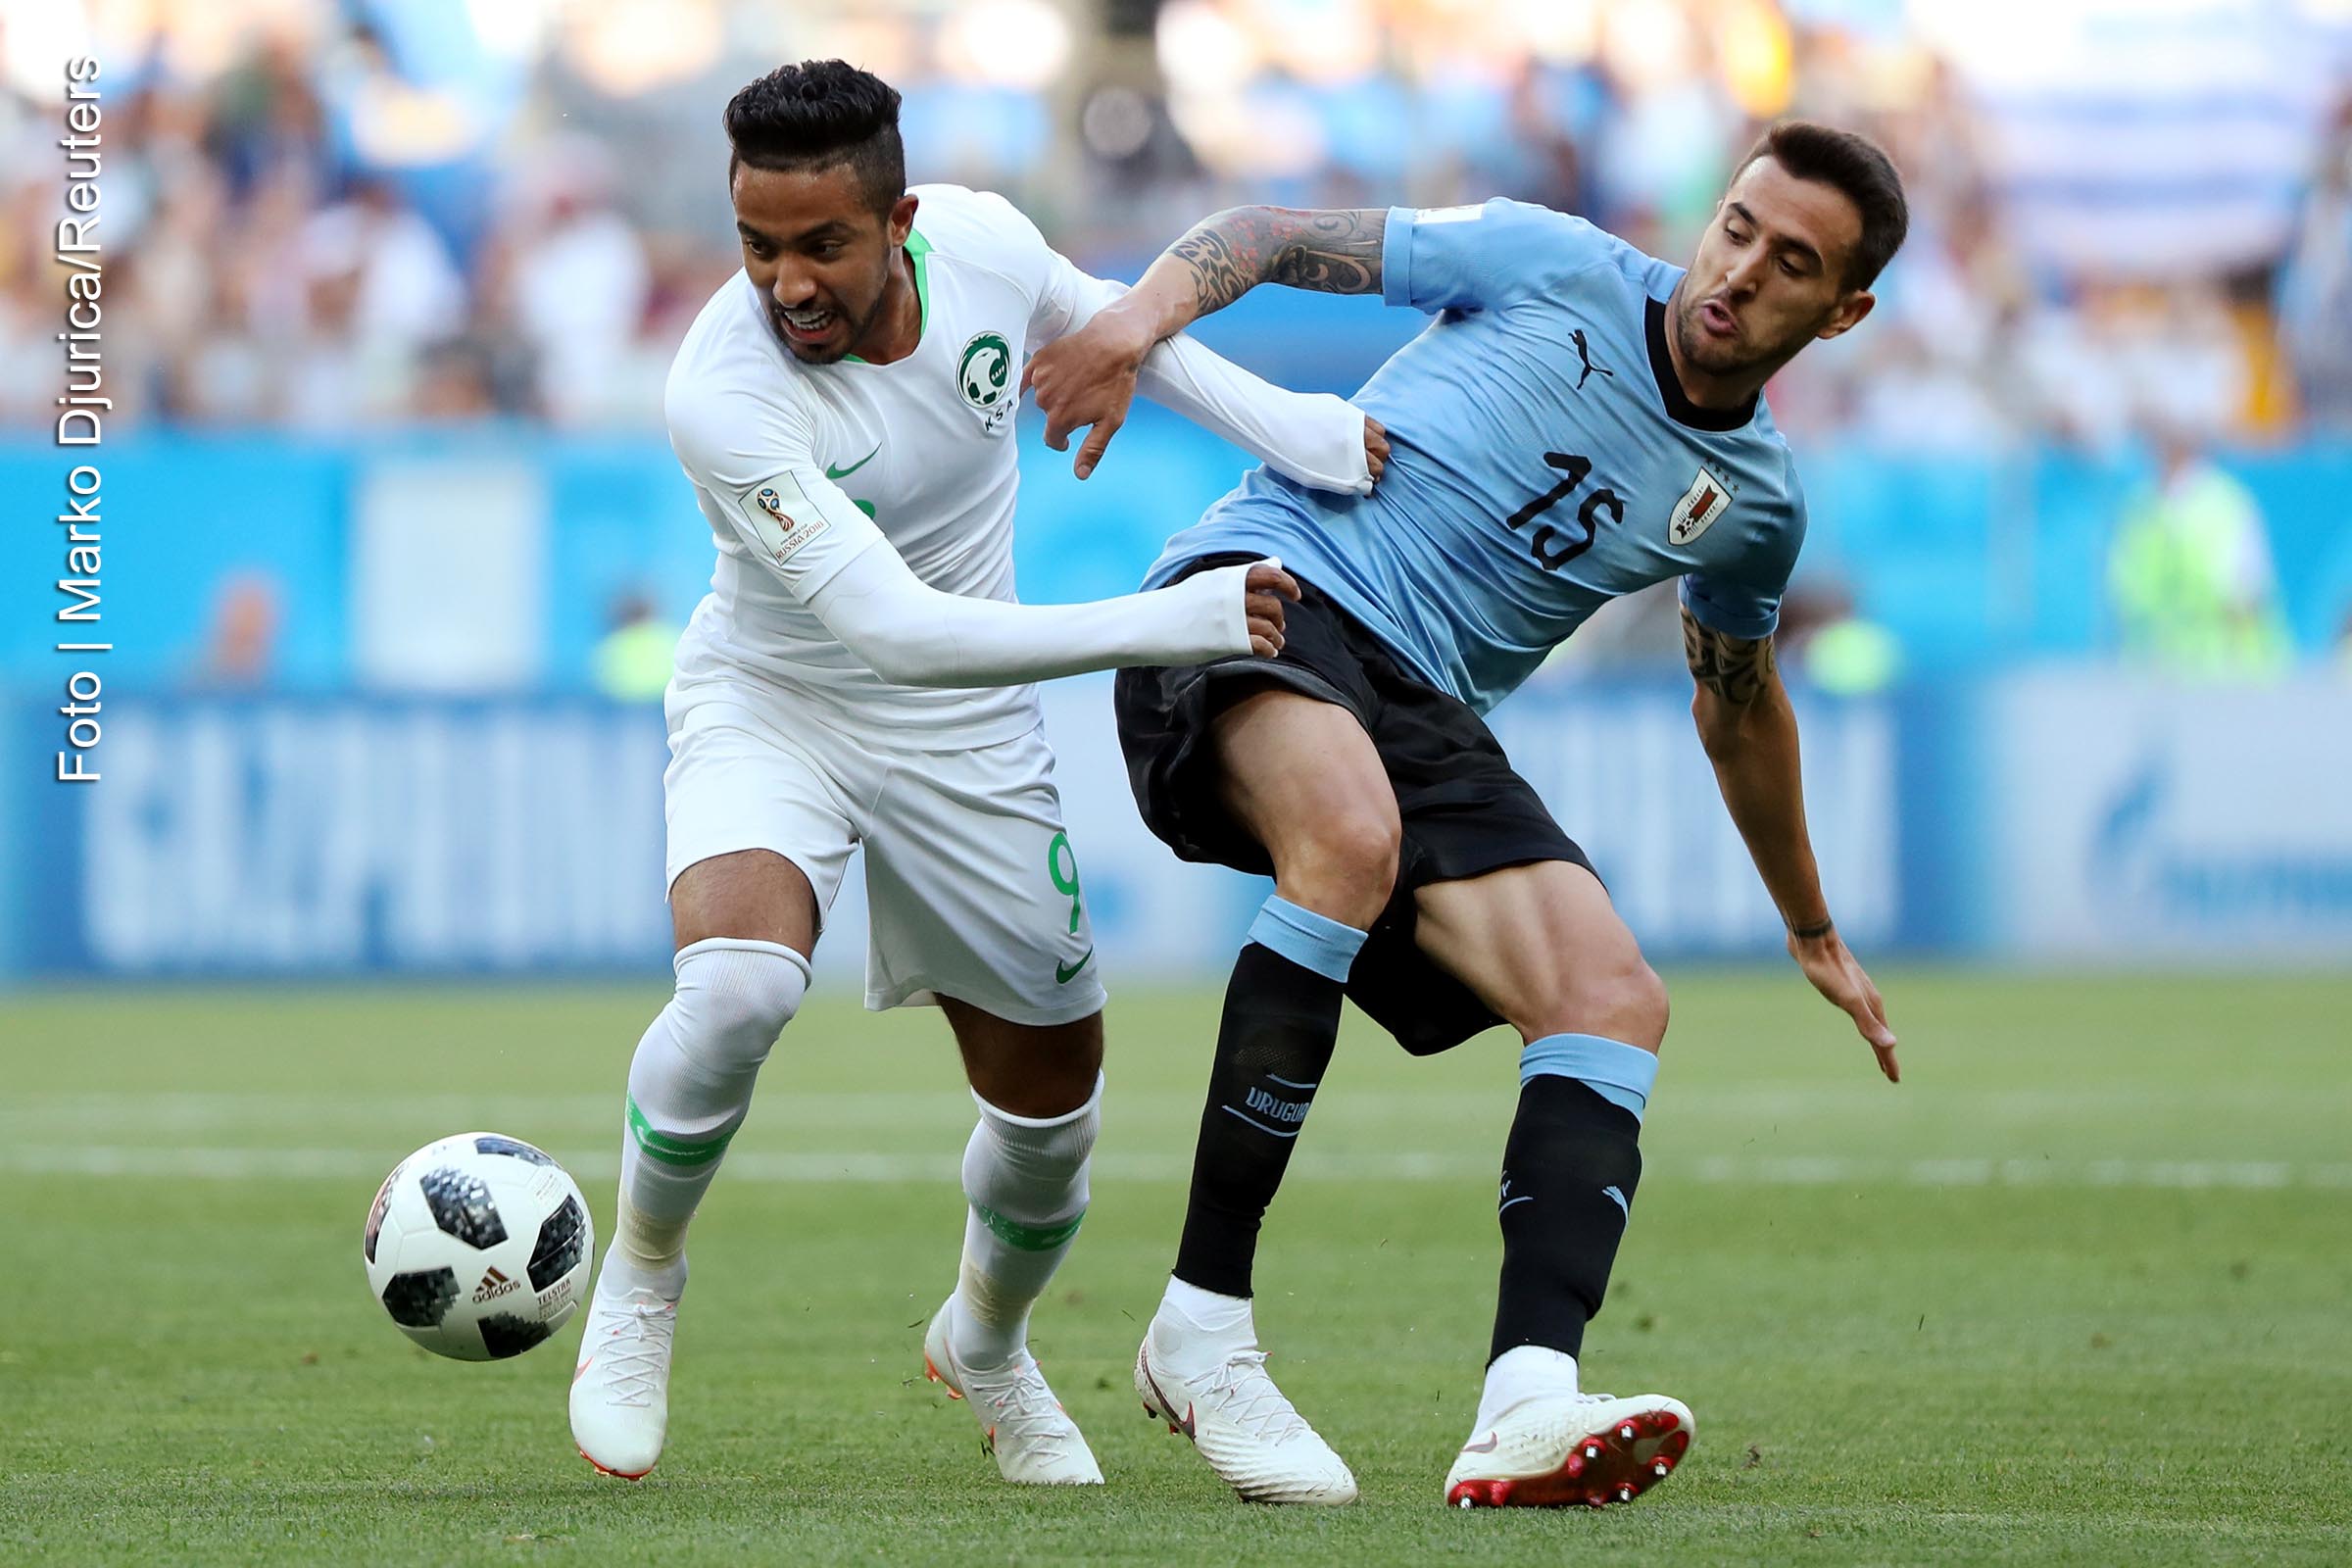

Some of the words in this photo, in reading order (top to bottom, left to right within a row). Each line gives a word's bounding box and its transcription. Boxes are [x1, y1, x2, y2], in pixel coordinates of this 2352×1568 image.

[1506, 451, 1624, 570] 15
[775, 535, 805, 561] RUSSIA
[1048, 830, 1081, 934] 9
[1246, 1086, 1310, 1123] URUGUA
[471, 1280, 521, 1304] adidas
